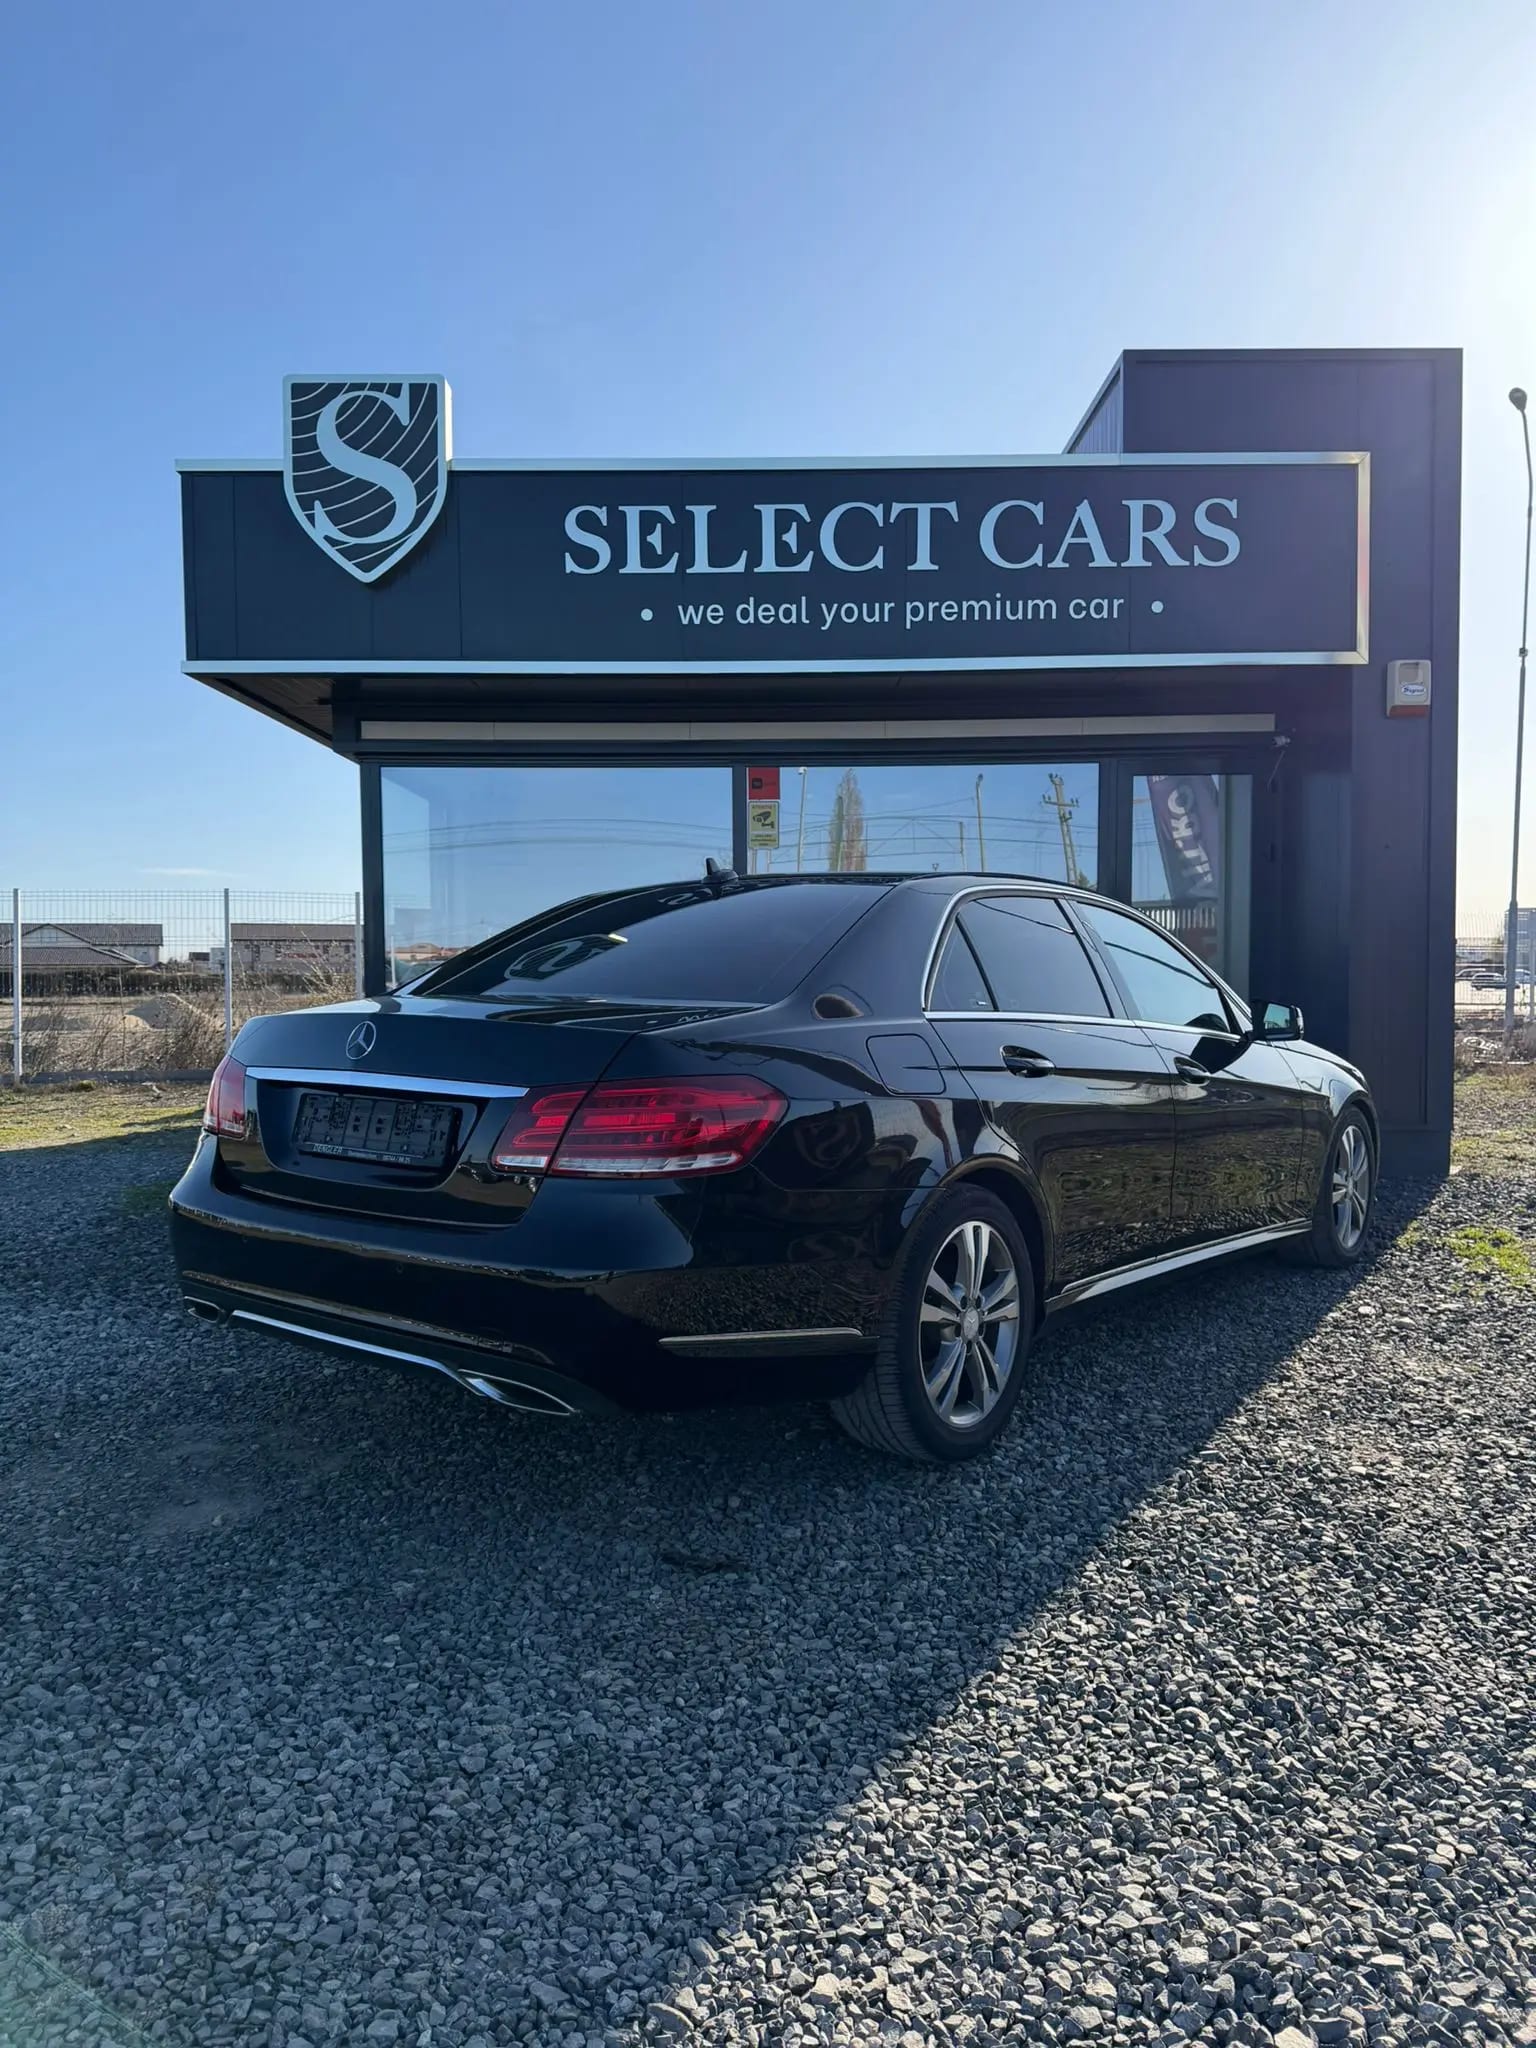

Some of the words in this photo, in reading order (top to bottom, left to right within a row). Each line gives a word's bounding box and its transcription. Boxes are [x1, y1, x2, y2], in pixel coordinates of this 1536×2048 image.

[314, 383, 417, 544] S
[563, 500, 960, 575] SELECT
[978, 497, 1241, 569] CARS
[677, 604, 724, 625] we
[735, 596, 810, 625] deal
[820, 602, 895, 631] your
[906, 593, 1057, 630] premium
[1068, 598, 1125, 620] car
